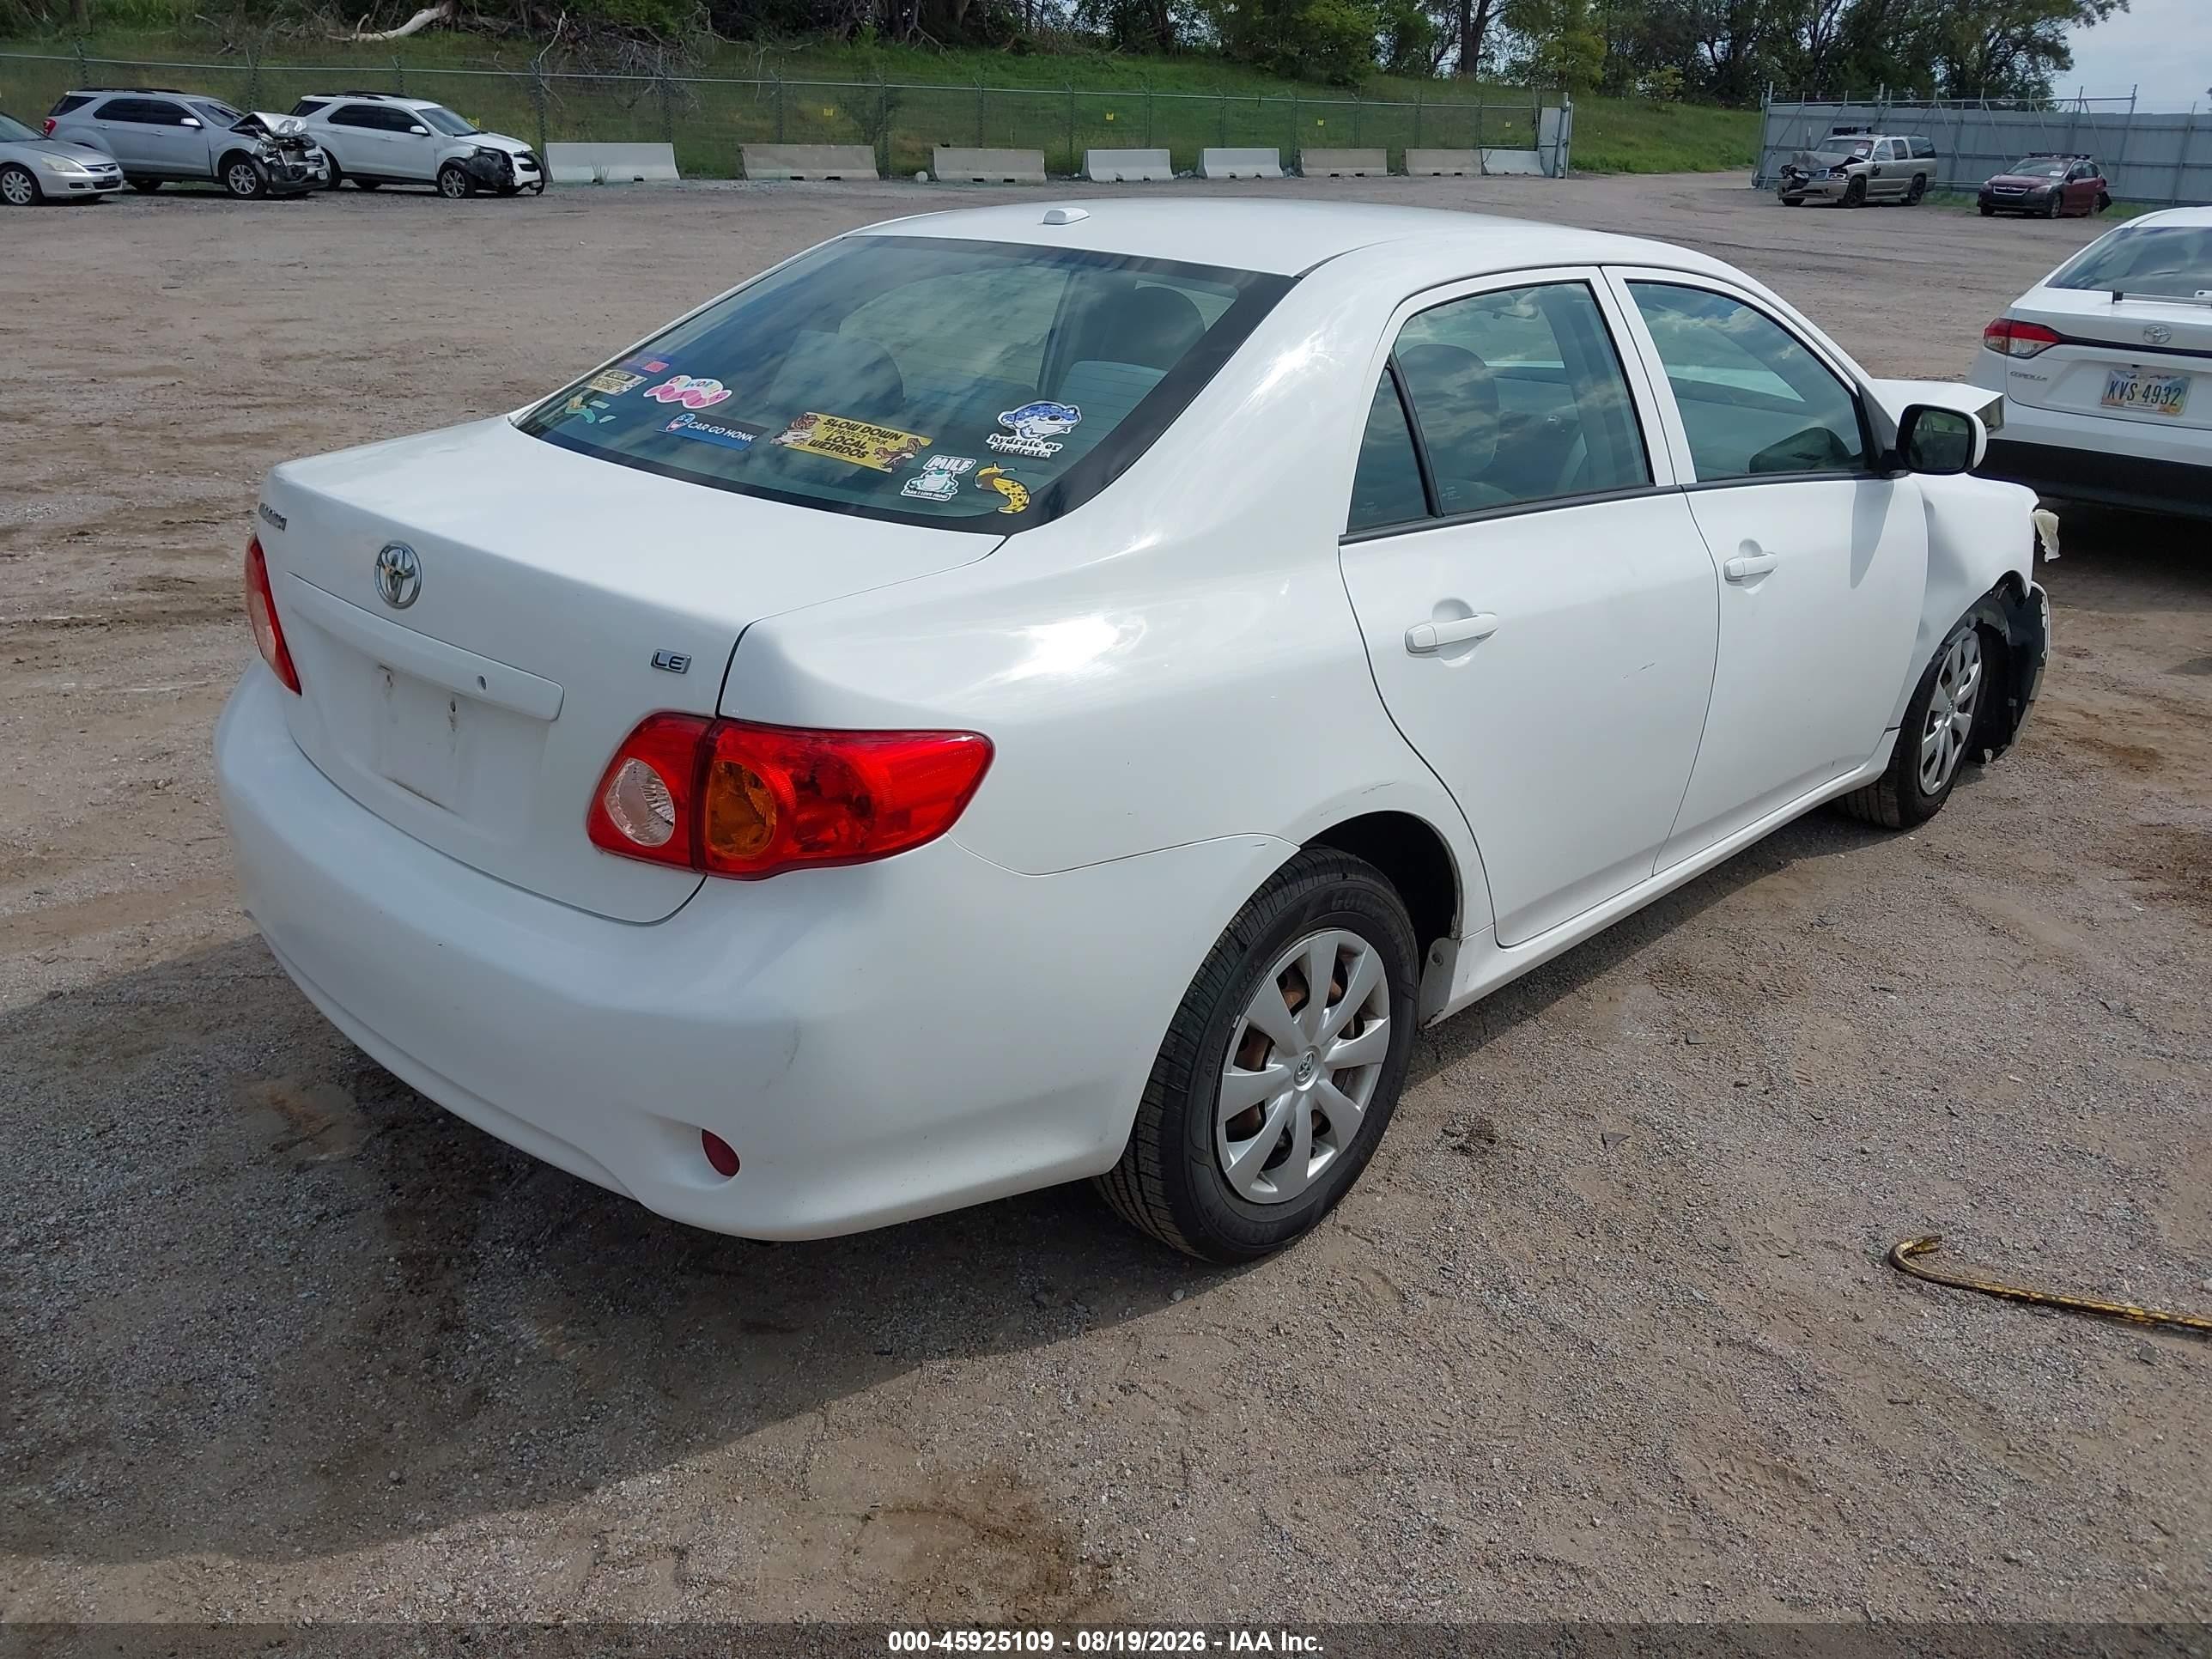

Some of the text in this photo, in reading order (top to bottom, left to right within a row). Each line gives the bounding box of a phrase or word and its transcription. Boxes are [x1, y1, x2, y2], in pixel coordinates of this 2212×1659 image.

[2106, 380, 2181, 406] KVS 4932
[688, 422, 757, 442] CAR GO HONK
[823, 418, 904, 441] SLOW DOWN
[833, 428, 866, 440] PROTECT
[866, 435, 888, 445] YOUR
[808, 440, 870, 459] WEIRDOS
[824, 434, 867, 449] LOCAL
[989, 434, 1042, 448] hydrate
[993, 444, 1048, 457] diedrate
[929, 457, 973, 471] MILF
[653, 651, 687, 672] LE
